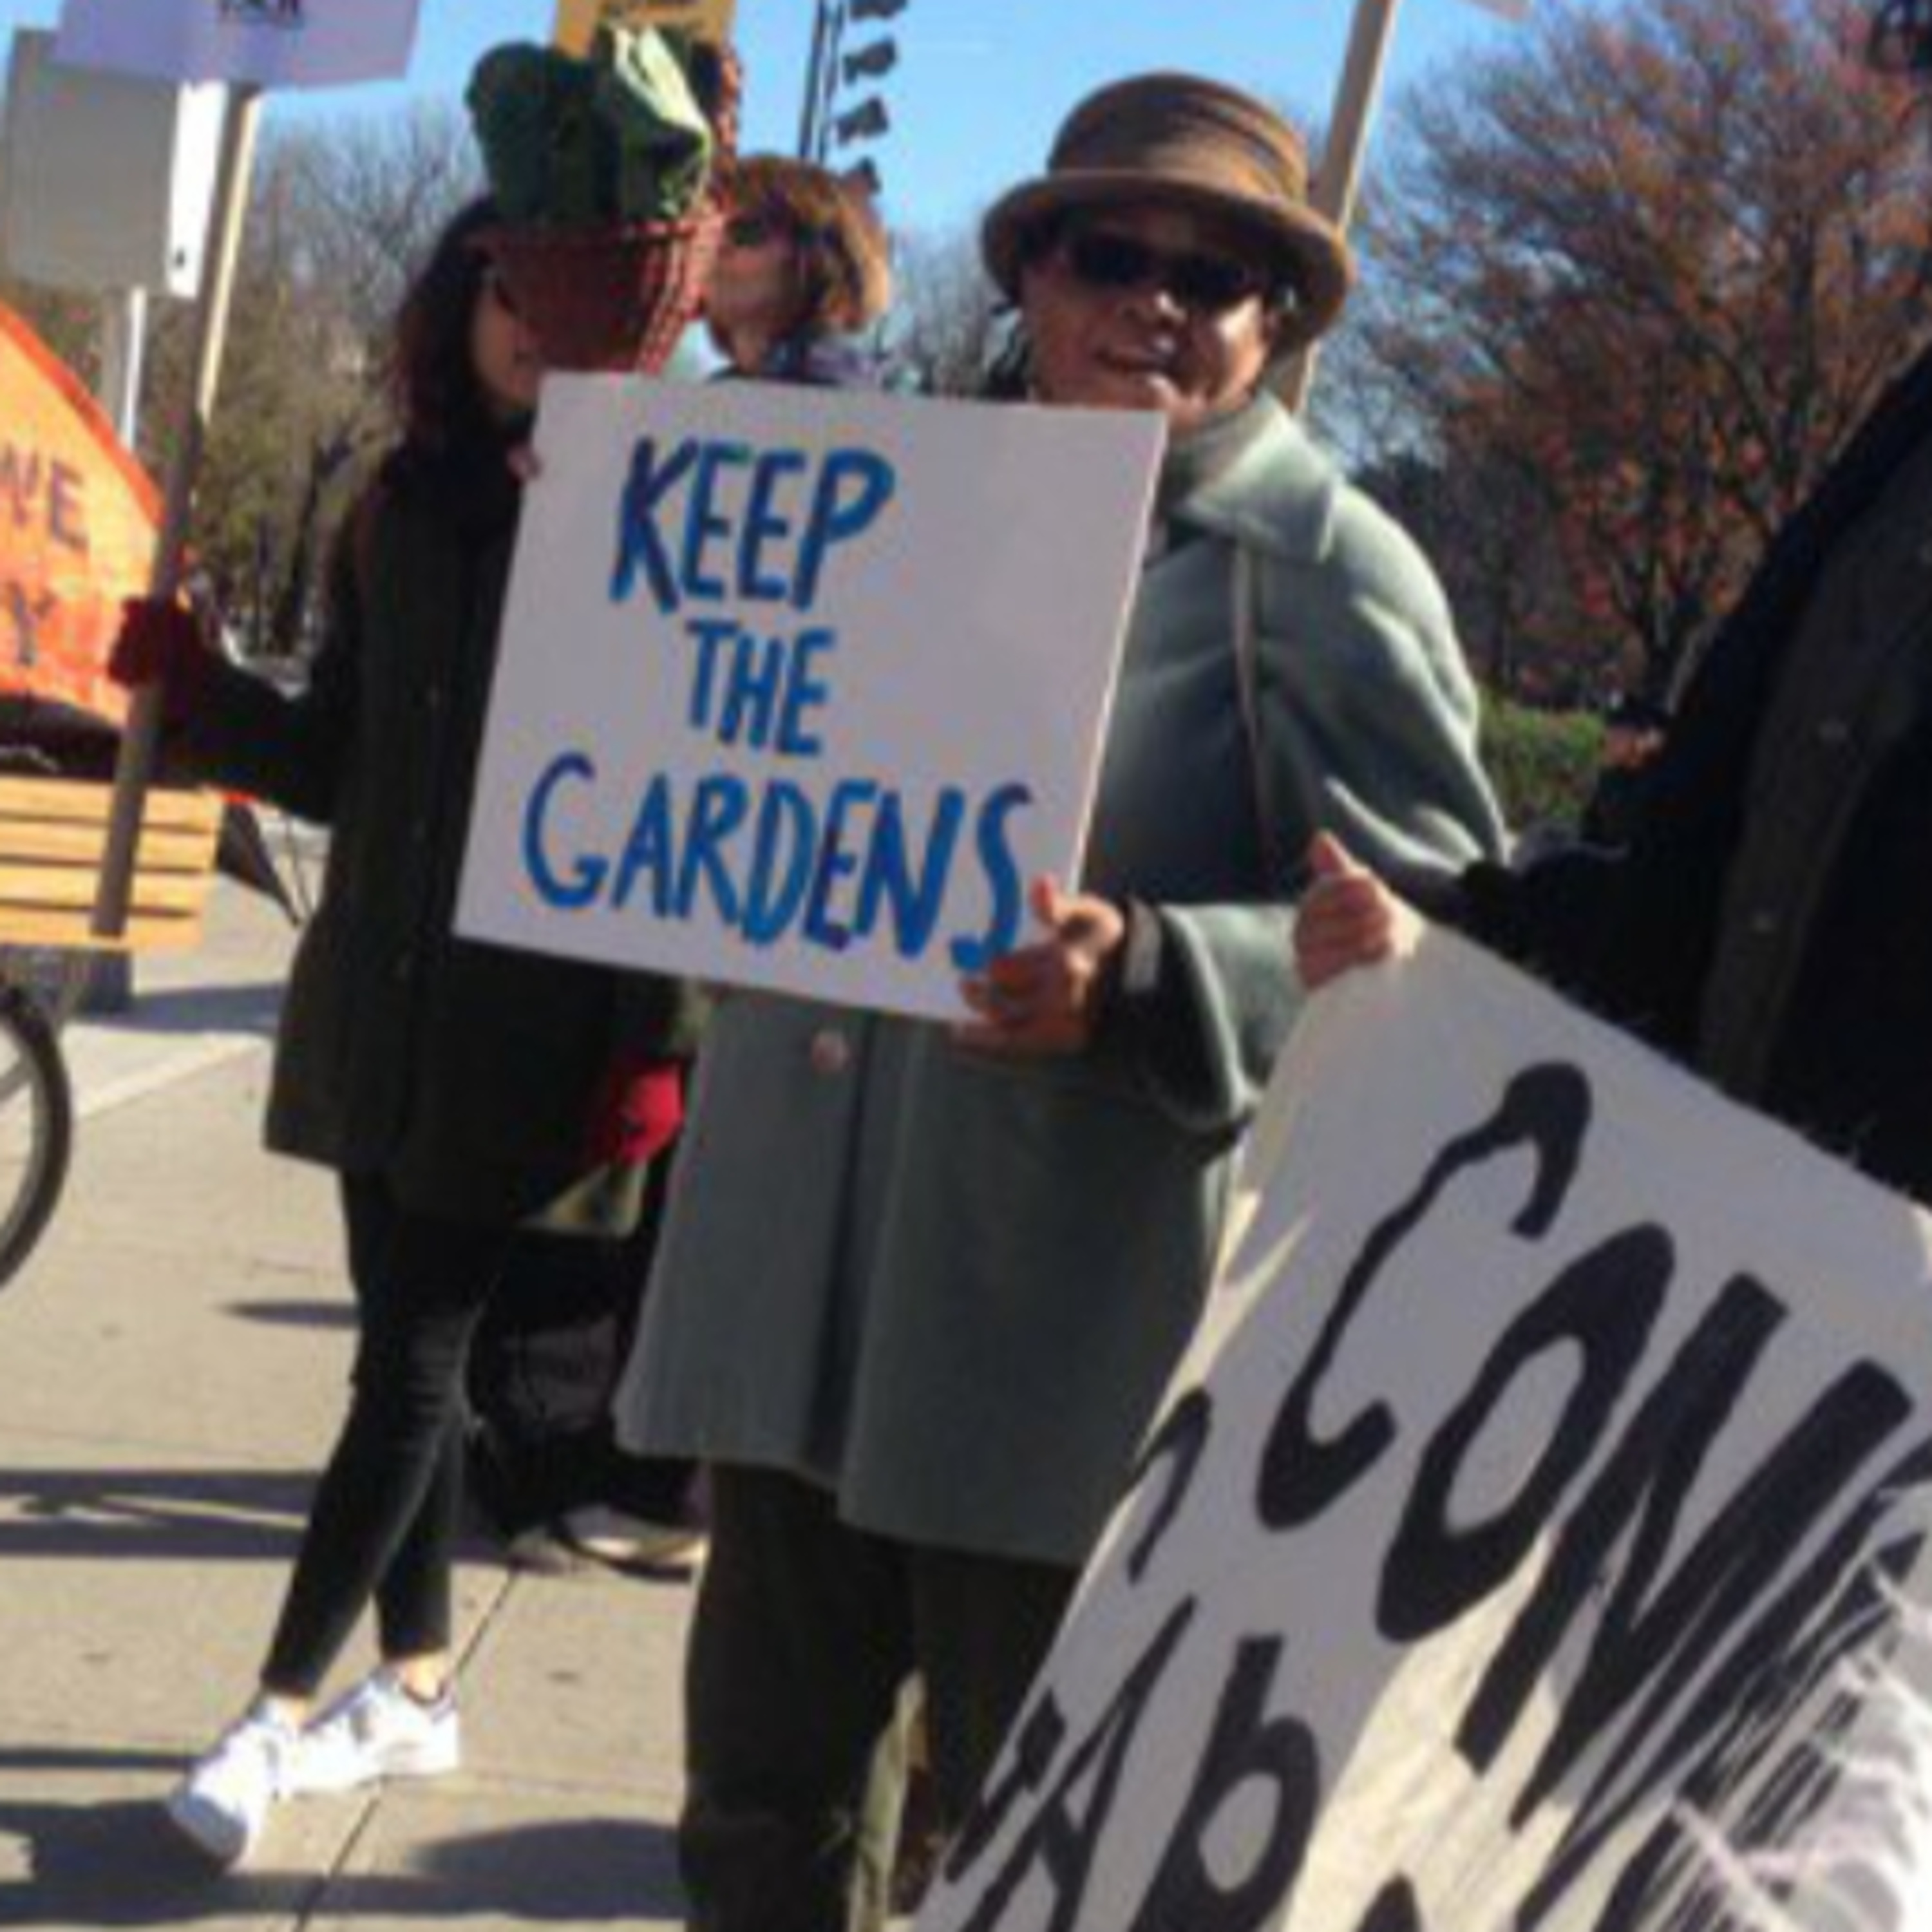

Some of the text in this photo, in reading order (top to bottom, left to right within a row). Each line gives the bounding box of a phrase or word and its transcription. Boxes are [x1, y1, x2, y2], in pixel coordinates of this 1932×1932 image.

[608, 435, 897, 614] KEEP
[685, 618, 837, 759] THE
[524, 750, 1033, 972] GARDENS
